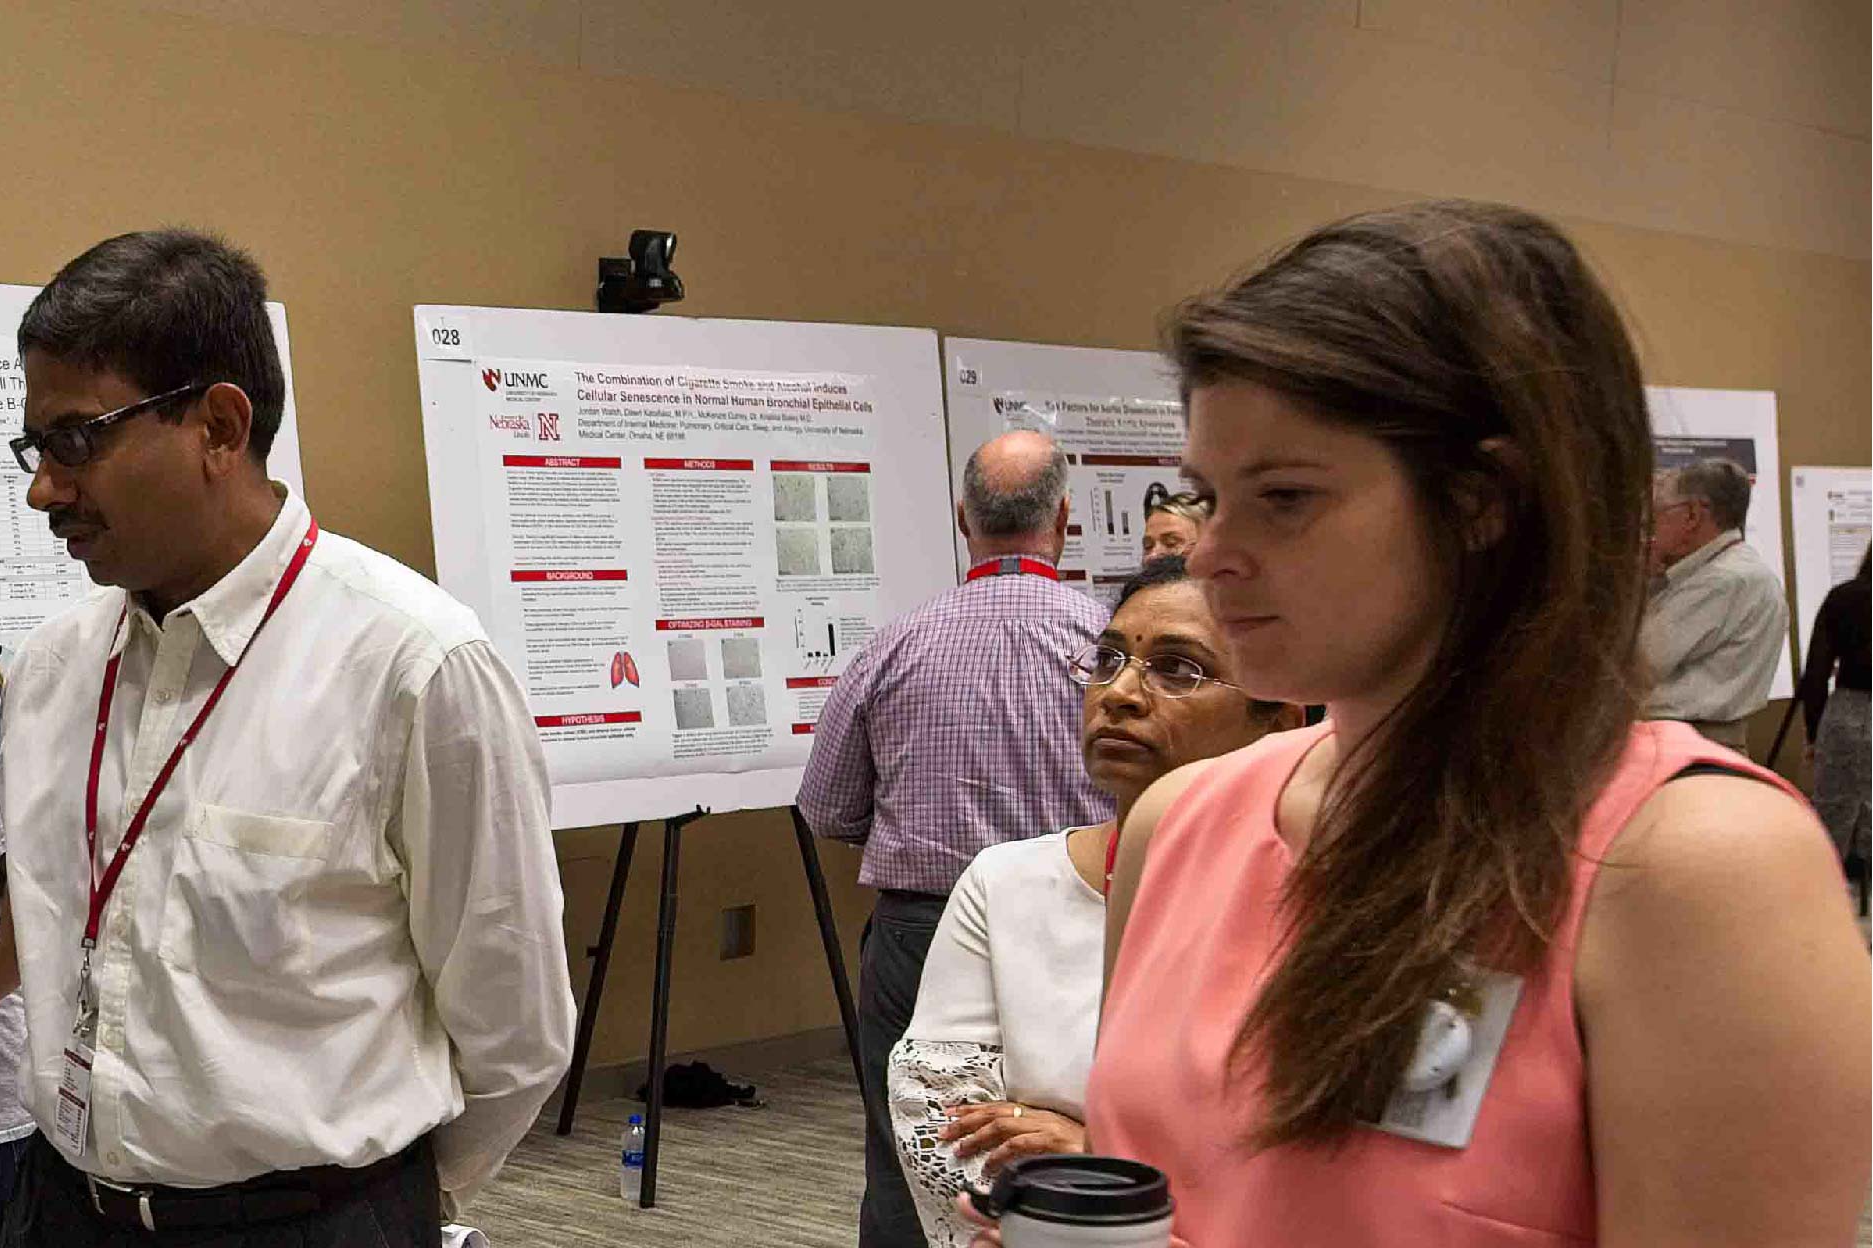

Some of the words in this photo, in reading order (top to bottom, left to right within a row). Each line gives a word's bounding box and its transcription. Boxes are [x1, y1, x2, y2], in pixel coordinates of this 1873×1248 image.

[432, 328, 460, 346] 028
[505, 372, 549, 389] UNMC
[574, 372, 595, 383] The
[598, 373, 662, 386] Combination
[665, 375, 674, 386] of
[814, 383, 847, 395] induces
[577, 389, 617, 401] Cellular
[620, 391, 680, 404] Senescence
[683, 394, 692, 403] in
[695, 394, 729, 406] Normal
[731, 396, 764, 407] Human
[767, 398, 810, 409] Bronchial
[813, 400, 851, 413] Epithelial
[853, 401, 872, 413] Cells
[489, 414, 530, 430] Nebraska
[538, 413, 560, 440] N
[578, 419, 616, 428] Department
[578, 430, 603, 439] Medical
[545, 458, 580, 467] ABSTRACT
[684, 460, 716, 469] METHODS
[546, 570, 594, 581] BACKGROUND
[561, 714, 606, 725] HYPOTHESIS
